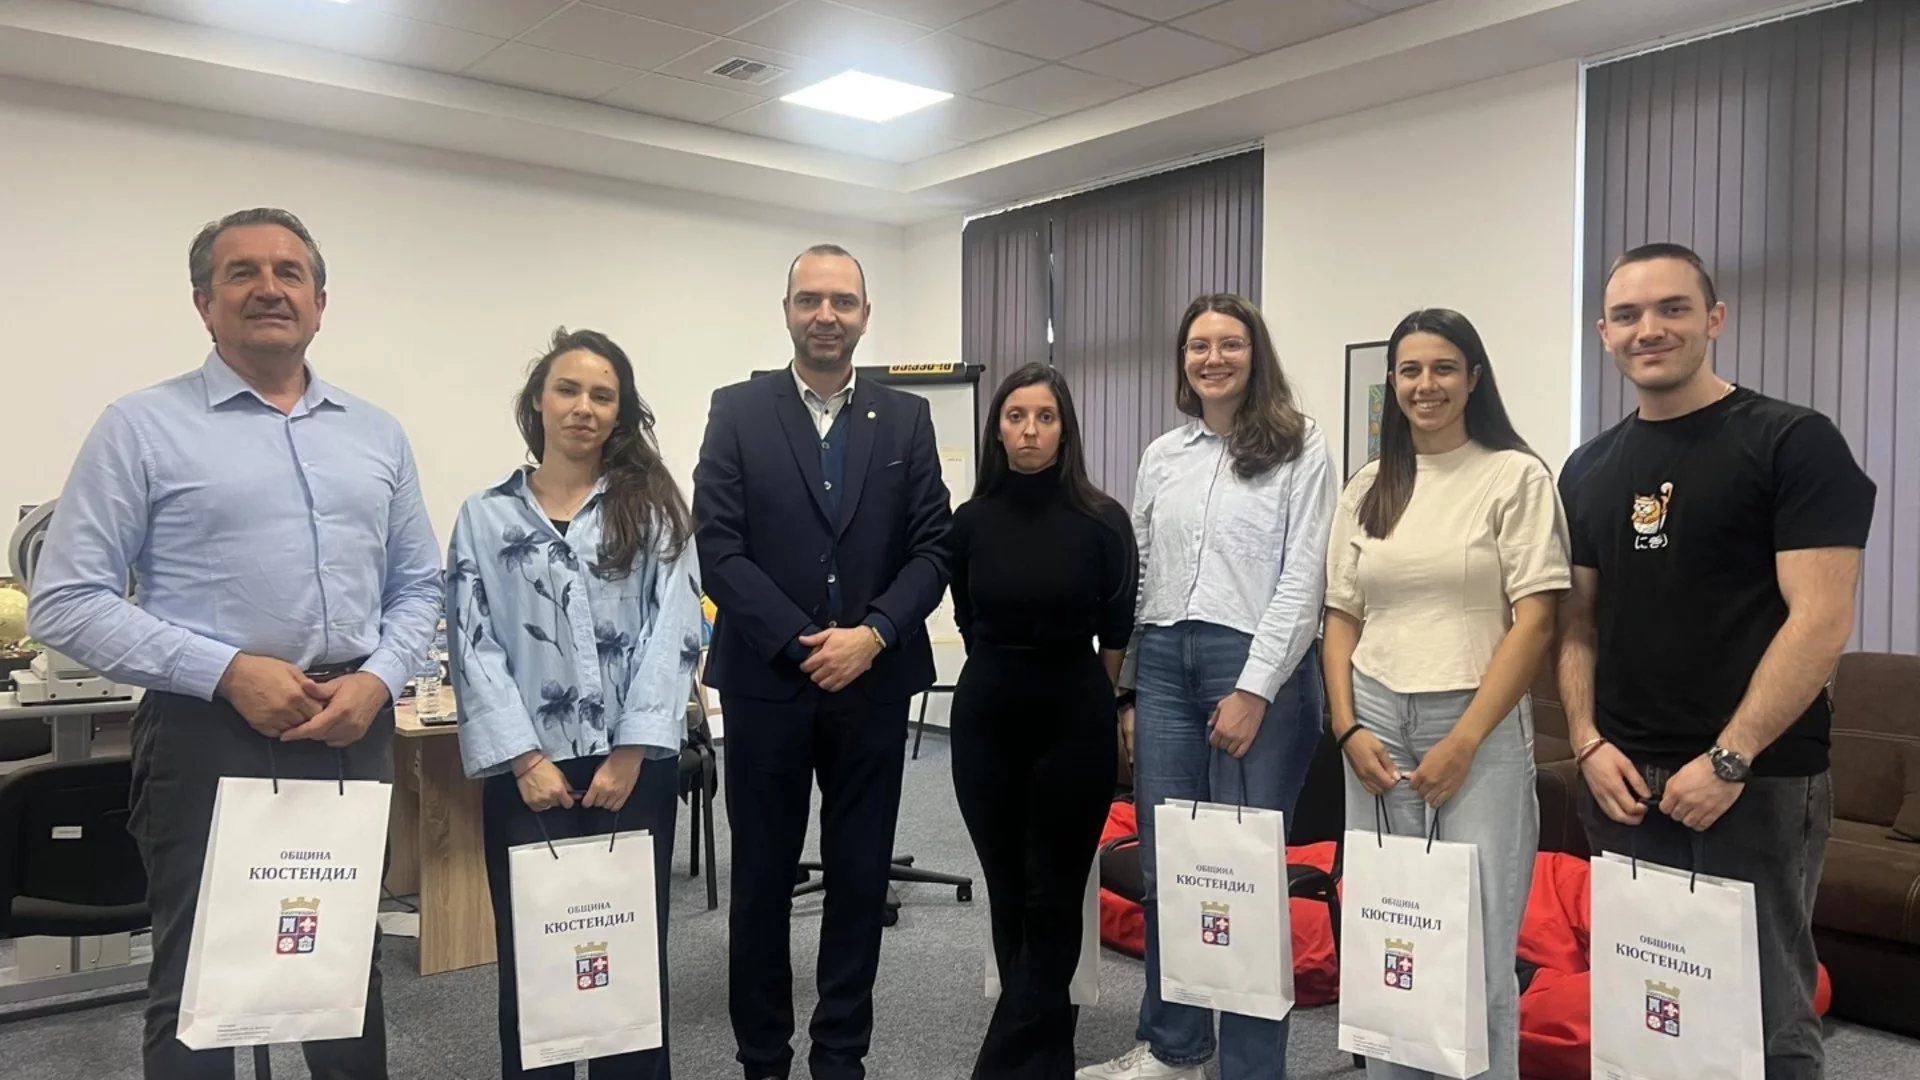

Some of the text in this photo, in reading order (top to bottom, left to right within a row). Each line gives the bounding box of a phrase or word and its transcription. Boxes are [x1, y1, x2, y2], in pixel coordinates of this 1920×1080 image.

[280, 850, 332, 861] ОБЩИНА
[249, 867, 358, 882] КЮСТЕНДИЛ
[1195, 864, 1235, 876] ОБЩИНА
[1176, 874, 1255, 894] КЮСТЕНДИЛ
[567, 901, 612, 914] ОБЩИНА
[1381, 896, 1420, 910] ОБЩИНА
[544, 911, 635, 934] КЮСТЕНДИЛ
[1361, 907, 1441, 931] КЮСТЕНДИЛ
[1639, 934, 1687, 955] ОБЩИНА
[1616, 942, 1712, 980] КЮСТЕНДИЛ
